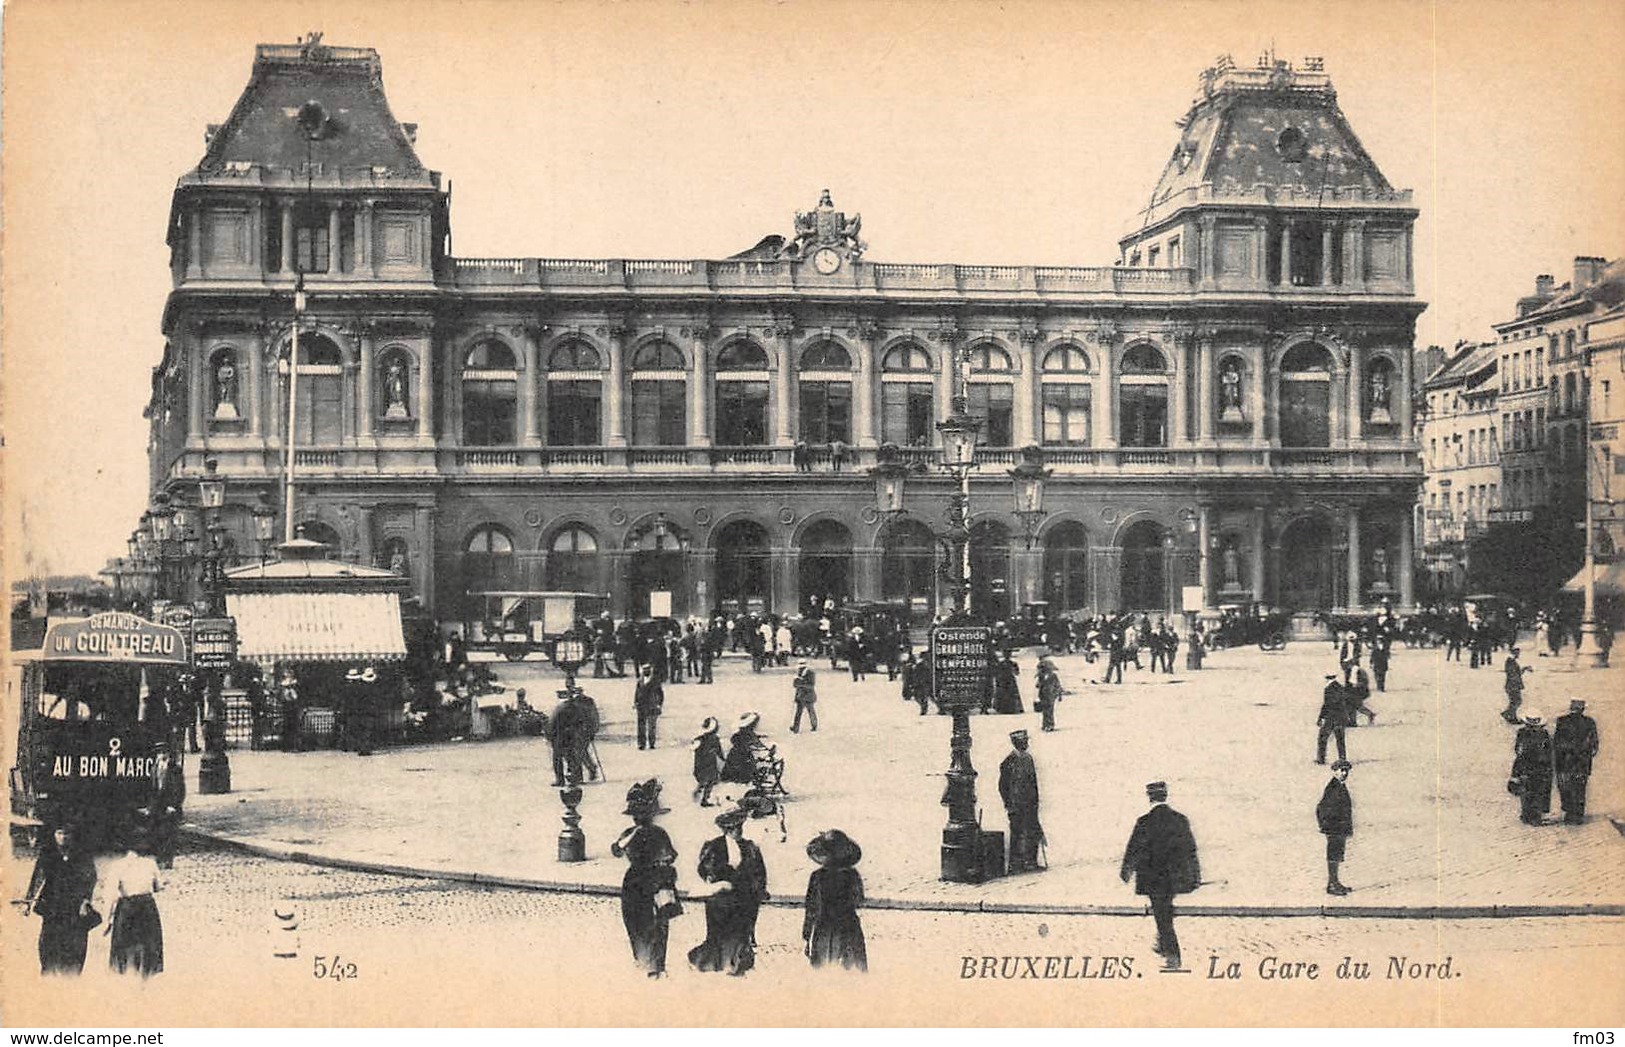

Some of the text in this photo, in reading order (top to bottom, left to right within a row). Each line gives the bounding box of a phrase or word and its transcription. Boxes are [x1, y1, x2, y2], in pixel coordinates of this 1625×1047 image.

[90, 614, 142, 630] DEMANDEZ
[55, 632, 175, 654] UN COINTREAU
[938, 631, 987, 640] Ostende
[109, 737, 121, 756] 2
[53, 755, 153, 777] AU BON MARC
